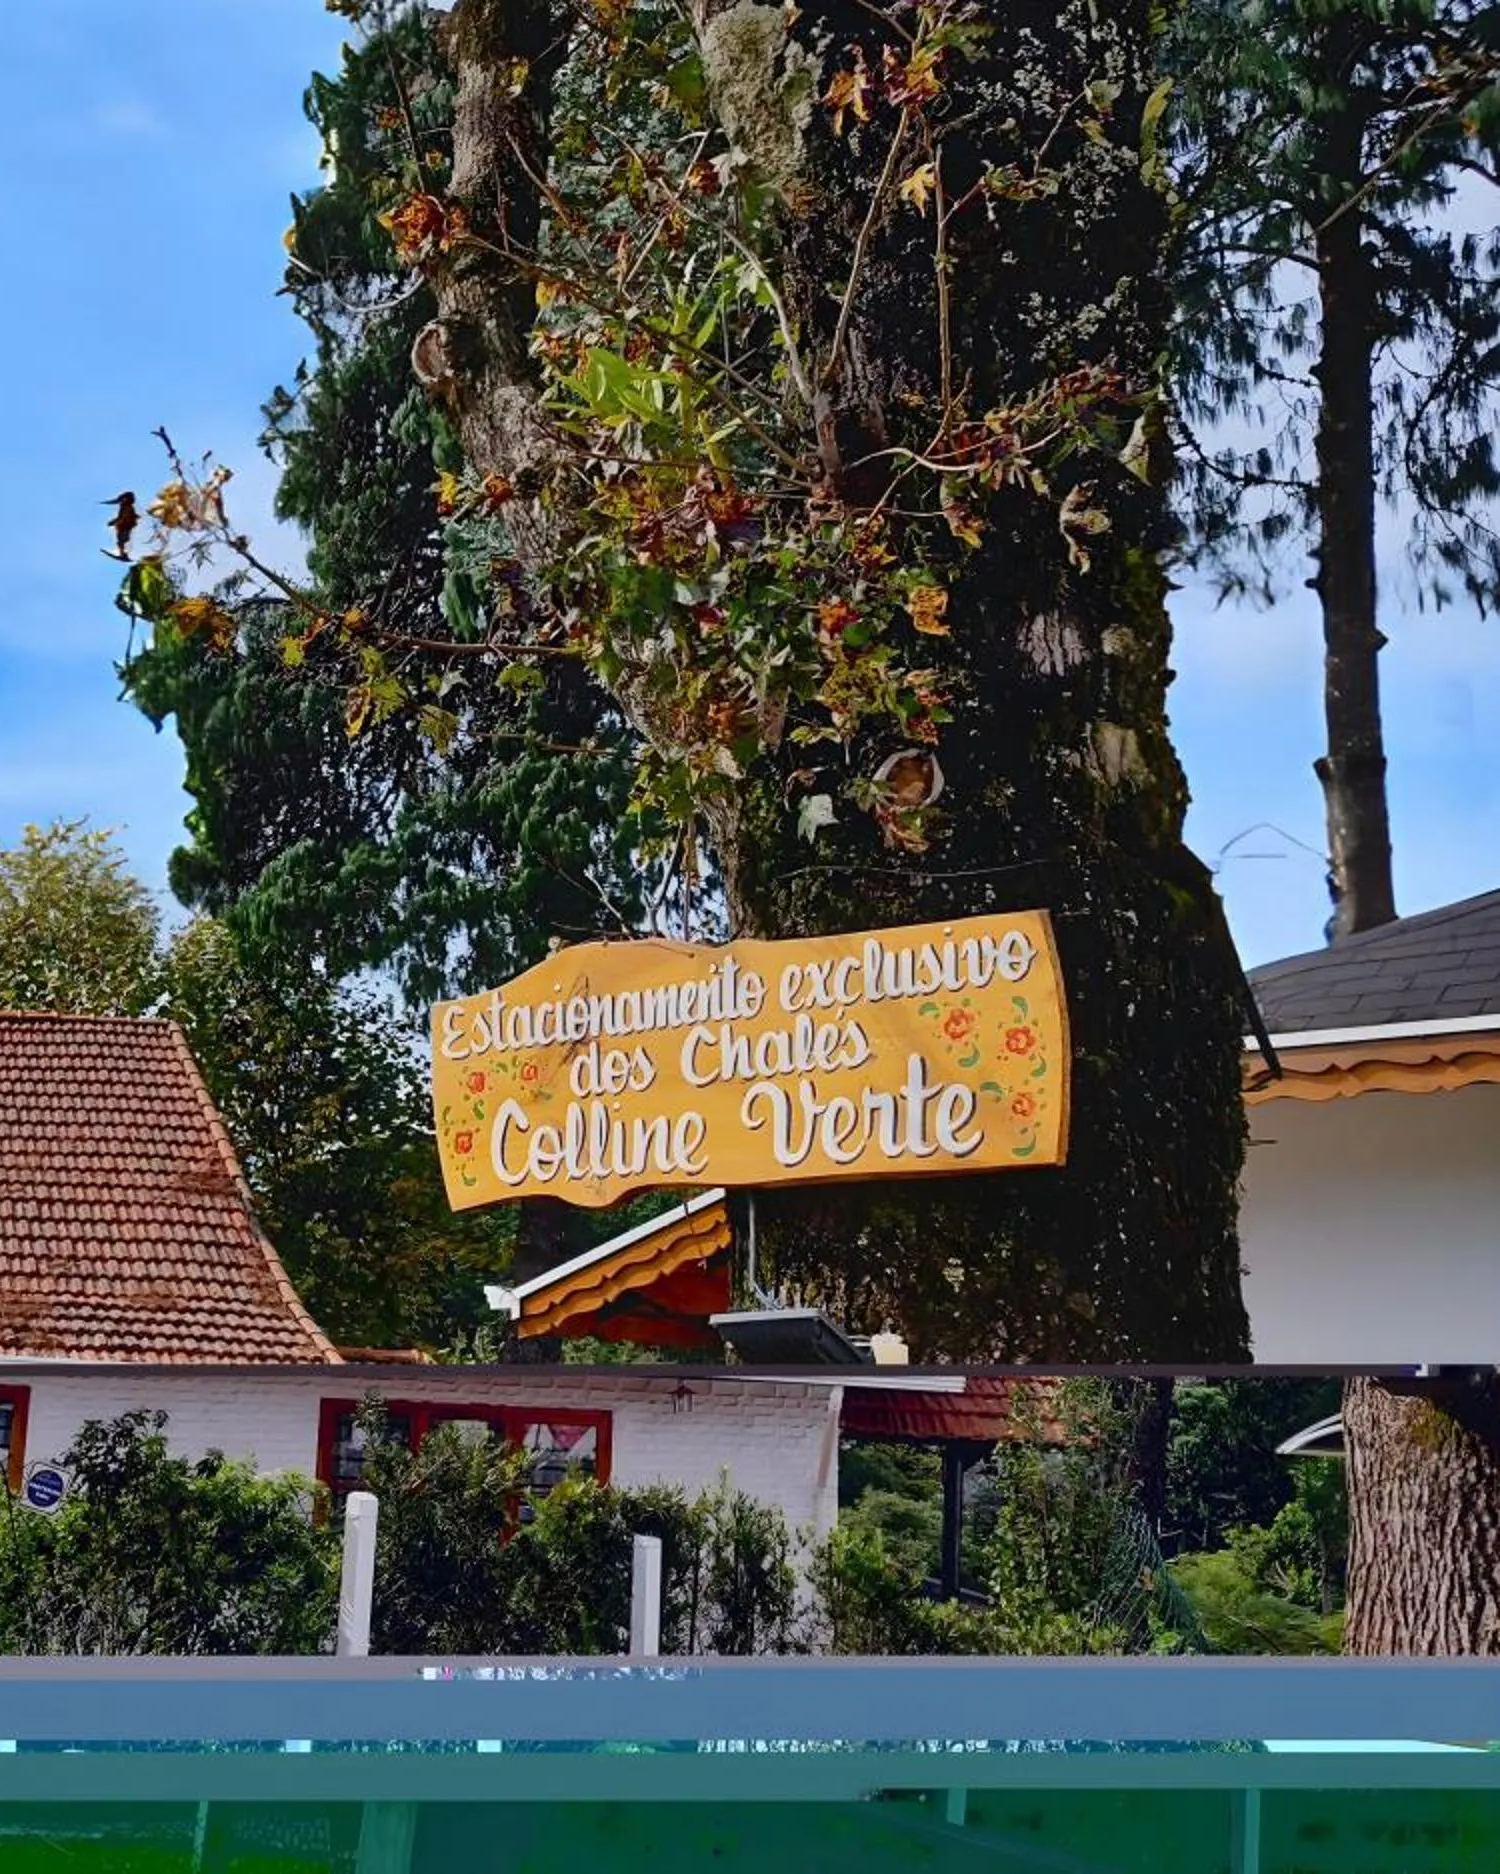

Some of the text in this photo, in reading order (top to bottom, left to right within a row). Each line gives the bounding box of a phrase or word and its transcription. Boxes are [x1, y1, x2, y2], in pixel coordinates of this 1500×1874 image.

[441, 929, 1038, 1059] Estacionamento exclusivo
[570, 1007, 870, 1098] dos Chalés
[489, 1052, 985, 1186] Colline Verte
